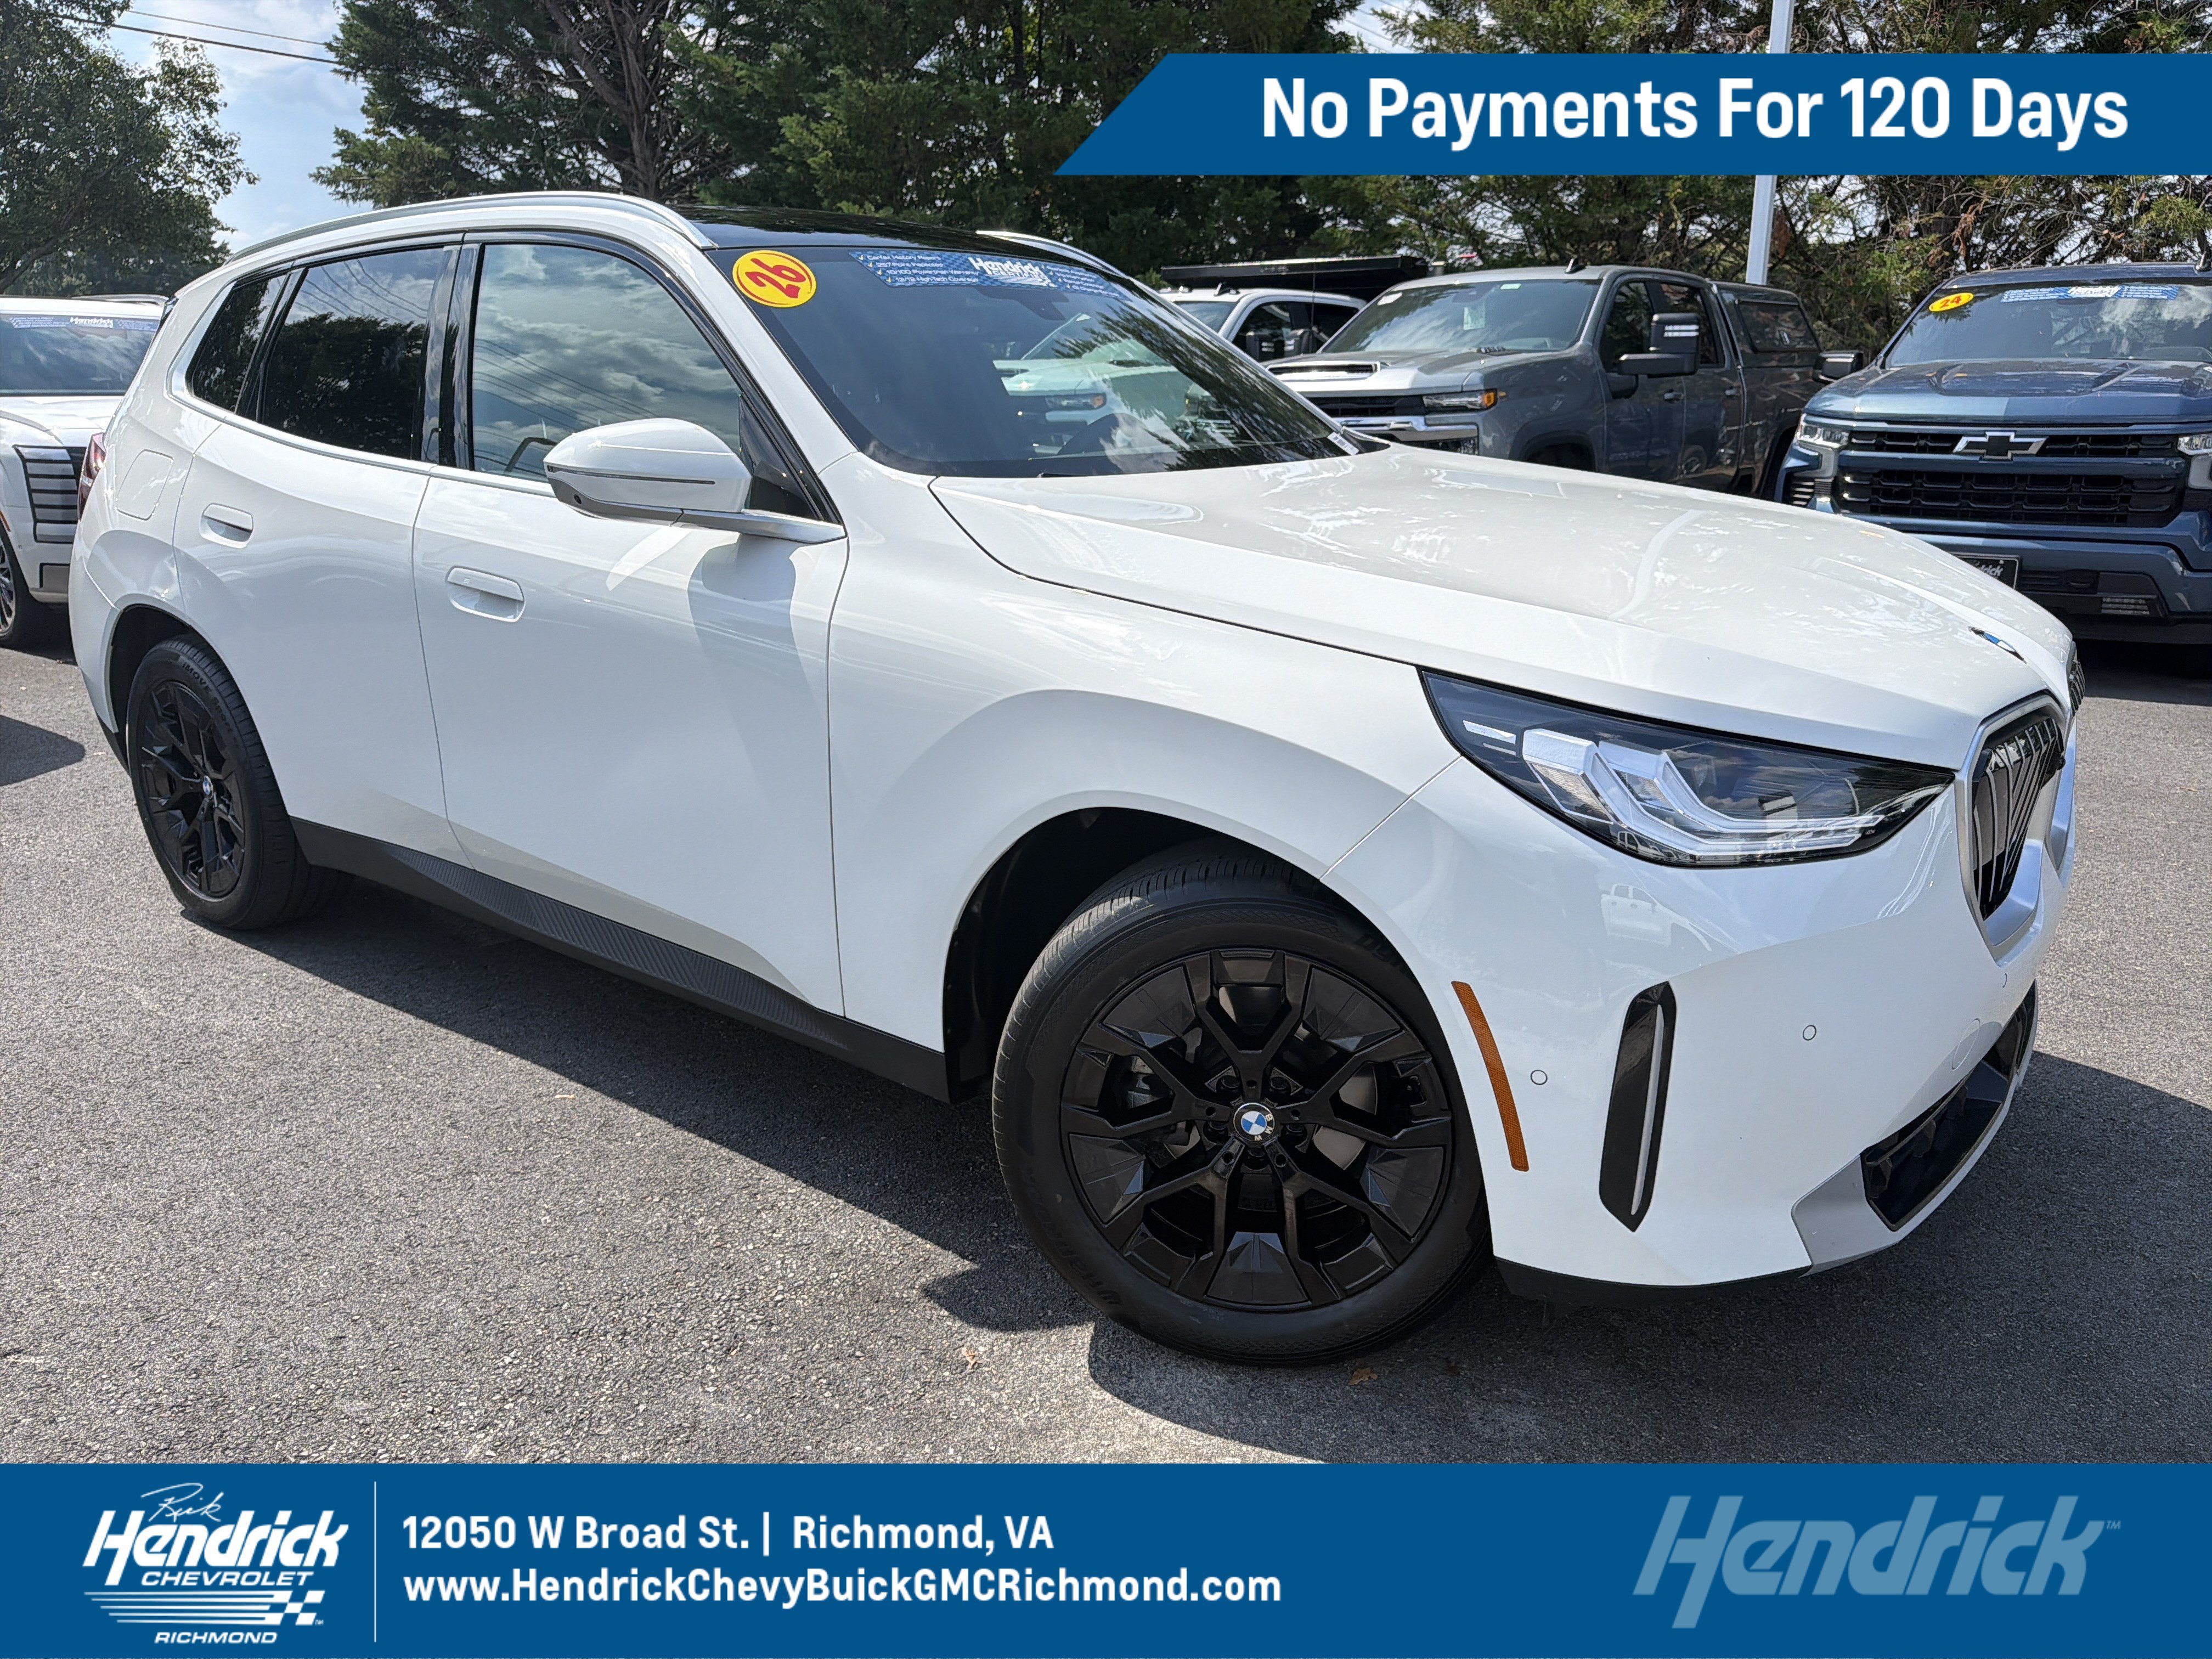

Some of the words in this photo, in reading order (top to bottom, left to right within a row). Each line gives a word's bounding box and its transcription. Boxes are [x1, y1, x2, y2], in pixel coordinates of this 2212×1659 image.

[968, 257, 1045, 275] Hendrick
[745, 258, 806, 299] 26
[1939, 296, 1962, 309] 24
[1254, 1113, 1274, 1142] BMW
